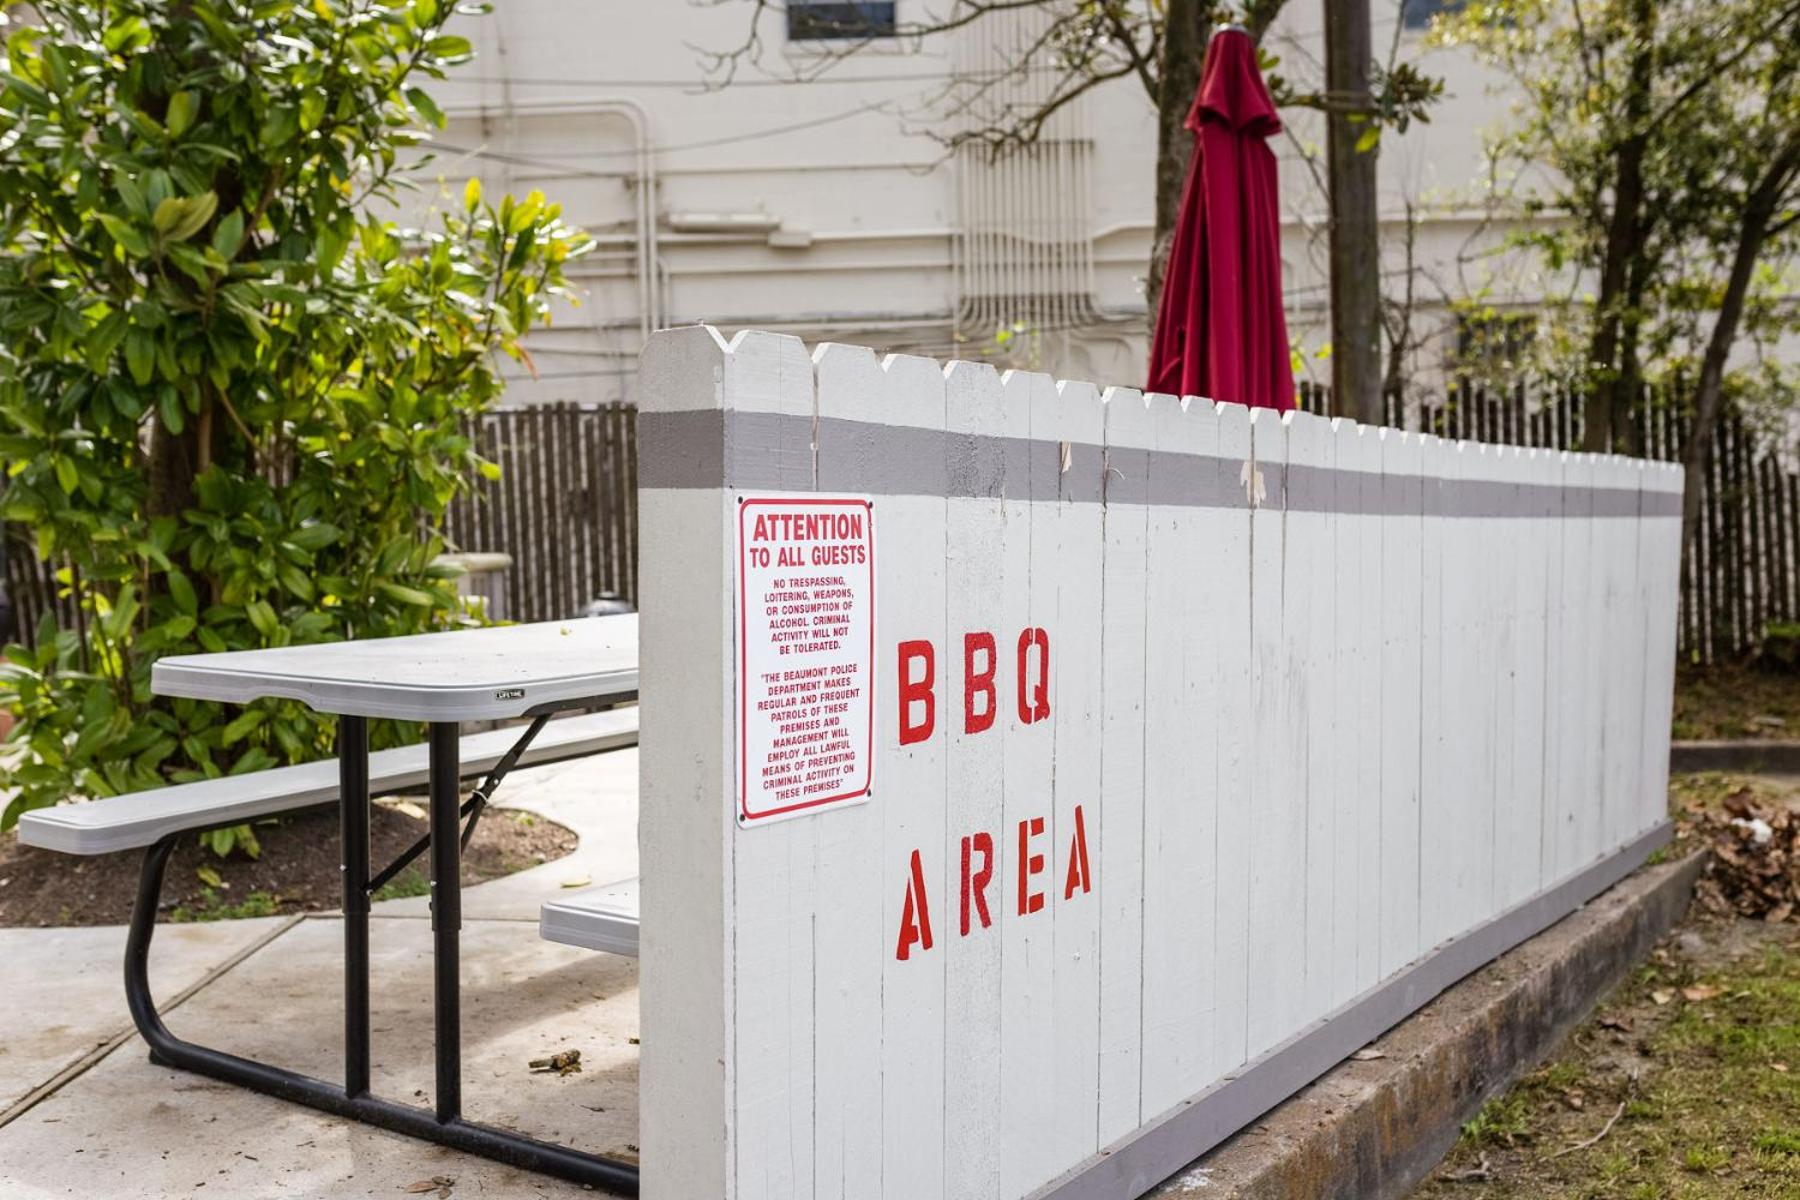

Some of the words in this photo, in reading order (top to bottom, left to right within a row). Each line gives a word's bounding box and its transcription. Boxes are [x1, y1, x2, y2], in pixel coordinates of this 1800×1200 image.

[753, 514, 862, 541] ATTENTION
[750, 547, 770, 568] TO
[777, 547, 805, 567] ALL
[811, 545, 865, 566] GUESTS
[773, 579, 785, 589] NO
[789, 576, 845, 588] TRESPASSING,
[813, 588, 854, 599] WEAPONS,
[766, 606, 778, 616] OR
[782, 602, 840, 615] CONSUMPTION
[843, 601, 853, 611] OF
[813, 614, 850, 626] CRIMINAL
[771, 630, 808, 642] ACTIVITY
[812, 628, 830, 639] WILL
[833, 627, 849, 637] NOT
[779, 645, 790, 655] BE
[794, 640, 841, 653] TOLERATED.
[784, 667, 827, 681] BEAUMONT
[830, 664, 857, 675] POLICE
[768, 681, 821, 696] DEPARTMENT
[824, 677, 851, 689] MAKES
[898, 627, 1050, 746] BBQ
[757, 697, 797, 711] REGULAR
[800, 694, 817, 705] AND
[820, 688, 860, 702] FREQUENT
[771, 709, 807, 722] PATROLS
[810, 706, 821, 716] OF
[824, 703, 848, 714] THESE
[780, 720, 820, 734] PREMISES
[824, 717, 840, 727] AND
[773, 731, 828, 748] MANAGEMENT
[831, 728, 849, 738] WILL
[767, 749, 800, 762] EMPLOY
[803, 746, 817, 756] ALL
[820, 740, 850, 753] LAWFUL
[762, 763, 791, 776] MEANS
[794, 761, 805, 771] OF
[808, 752, 855, 769] PREVENTING
[763, 775, 802, 790] CRIMINAL
[805, 767, 840, 782] ACTIVITY
[843, 764, 854, 774] ON
[776, 787, 800, 800] THESE
[896, 805, 1091, 961] AREA
